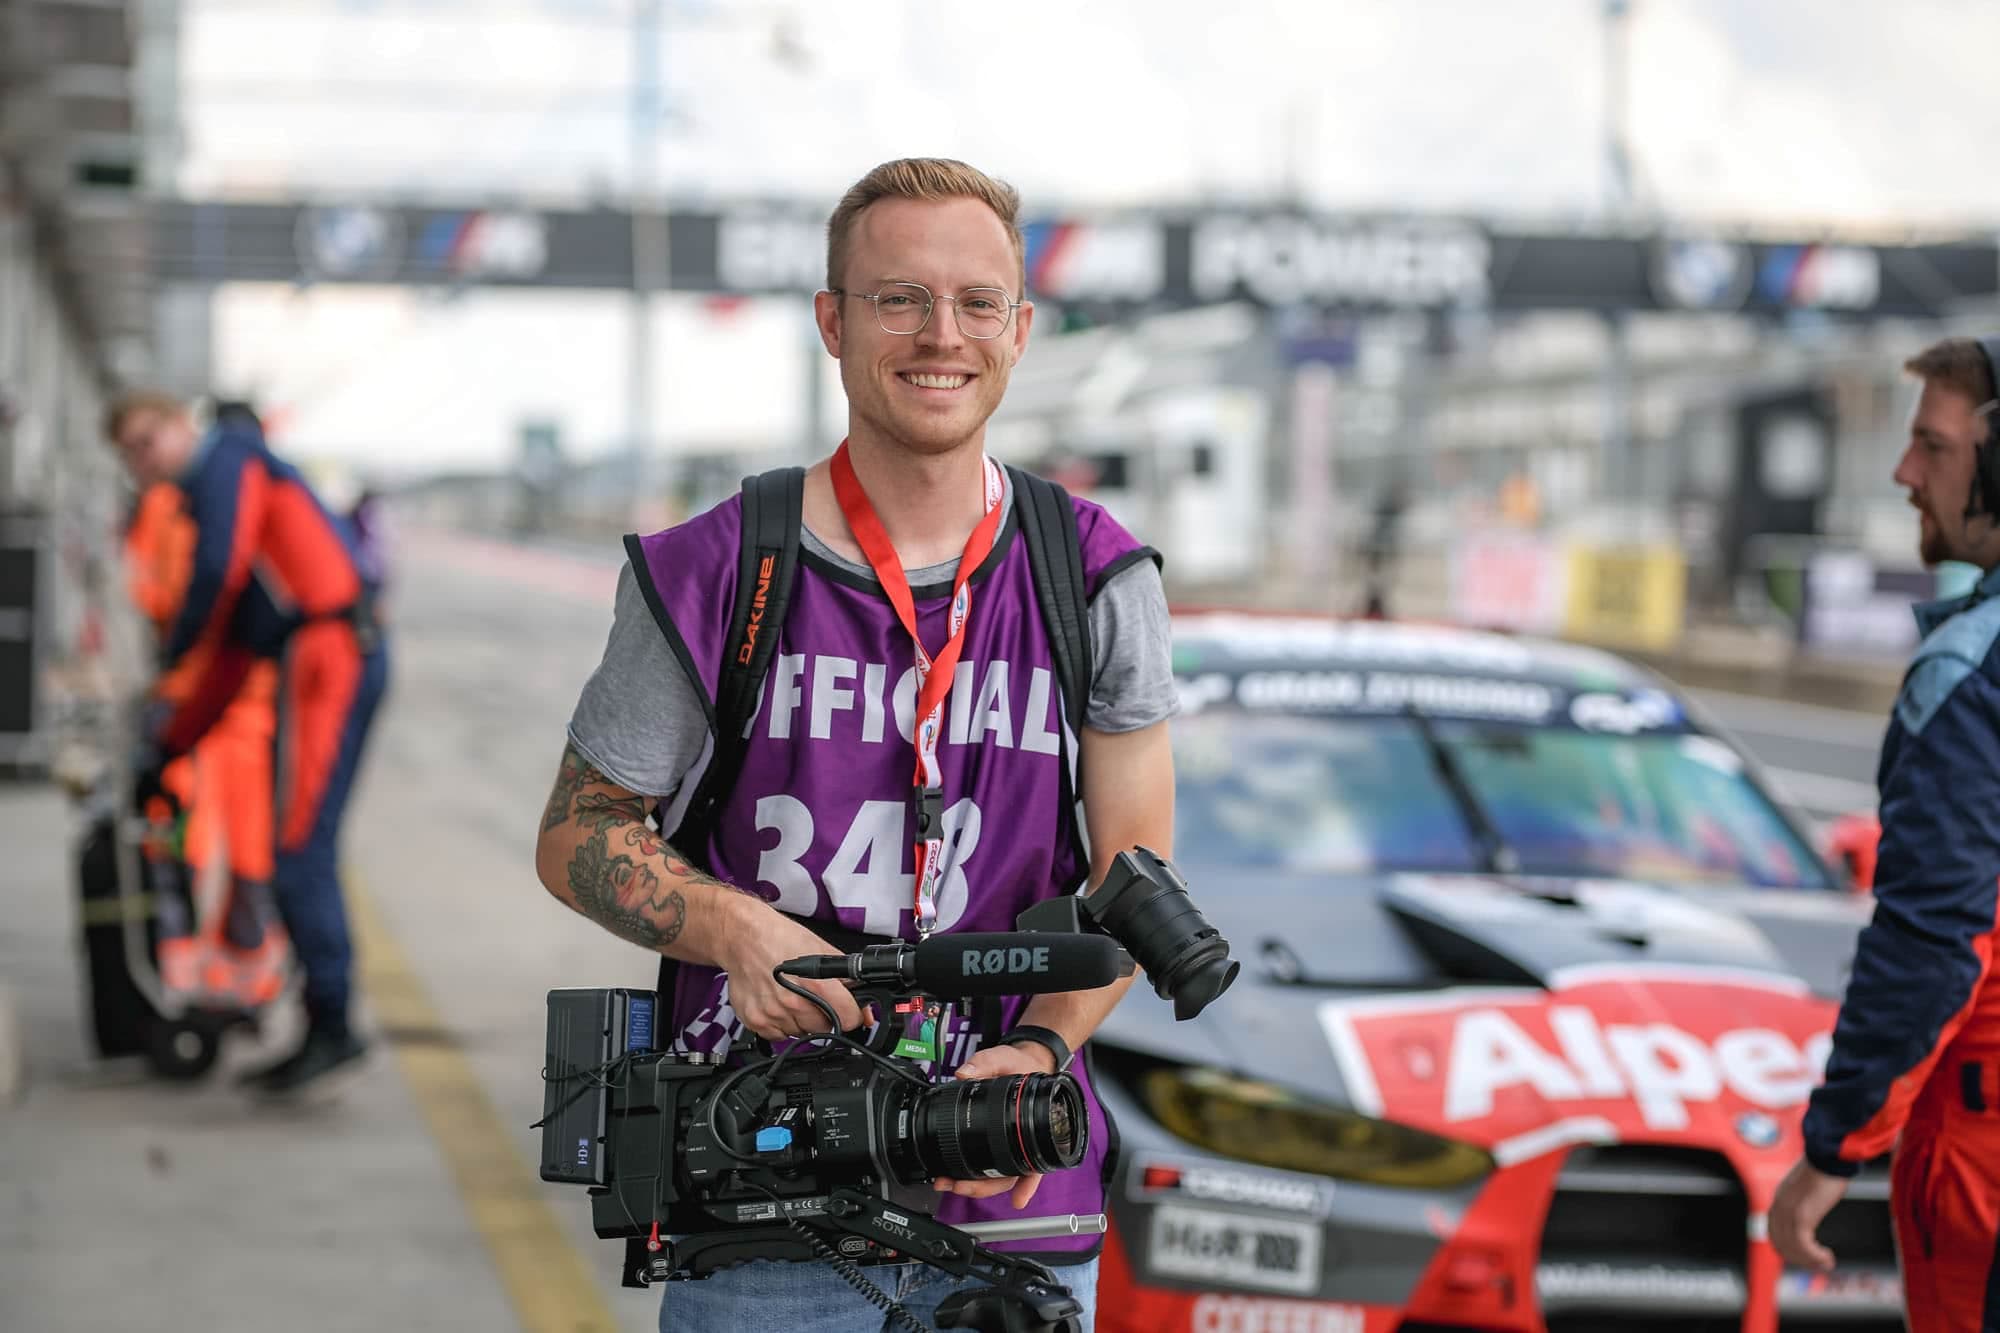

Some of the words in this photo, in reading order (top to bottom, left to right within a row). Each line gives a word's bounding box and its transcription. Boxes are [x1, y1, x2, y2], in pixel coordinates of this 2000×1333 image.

[738, 554, 775, 665] DAKINE
[962, 947, 1049, 976] RØDE
[871, 1216, 917, 1240] SONY
